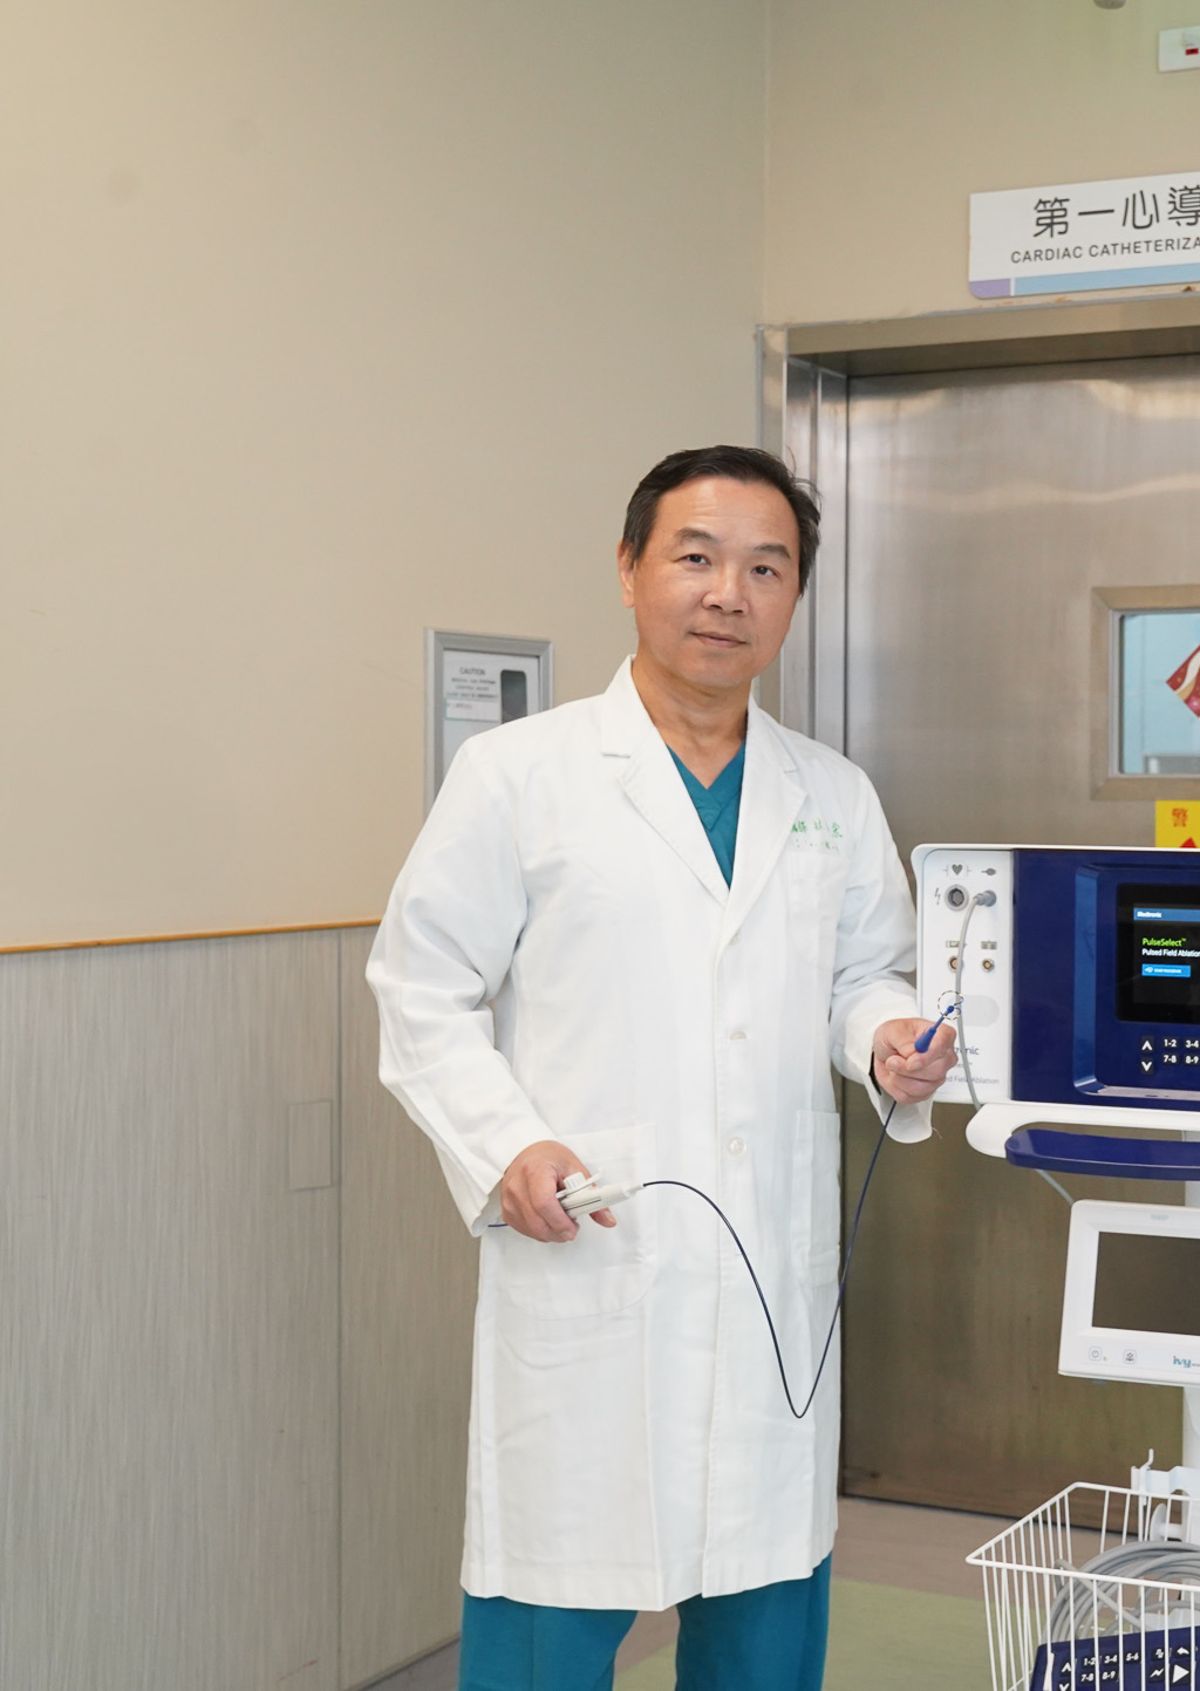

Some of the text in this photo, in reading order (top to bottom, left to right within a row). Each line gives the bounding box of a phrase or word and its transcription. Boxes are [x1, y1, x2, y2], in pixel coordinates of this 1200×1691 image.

[1010, 245, 1083, 264] CARDIAC
[1142, 948, 1162, 956] Pulsed
[1163, 949, 1177, 957] Field
[1164, 1039, 1177, 1048] 1-2
[1185, 1040, 1199, 1048] 3-4
[1163, 1055, 1199, 1064] 7-8 8-9
[1126, 1652, 1139, 1661] 5-6
[1081, 1673, 1094, 1682] 7-8
